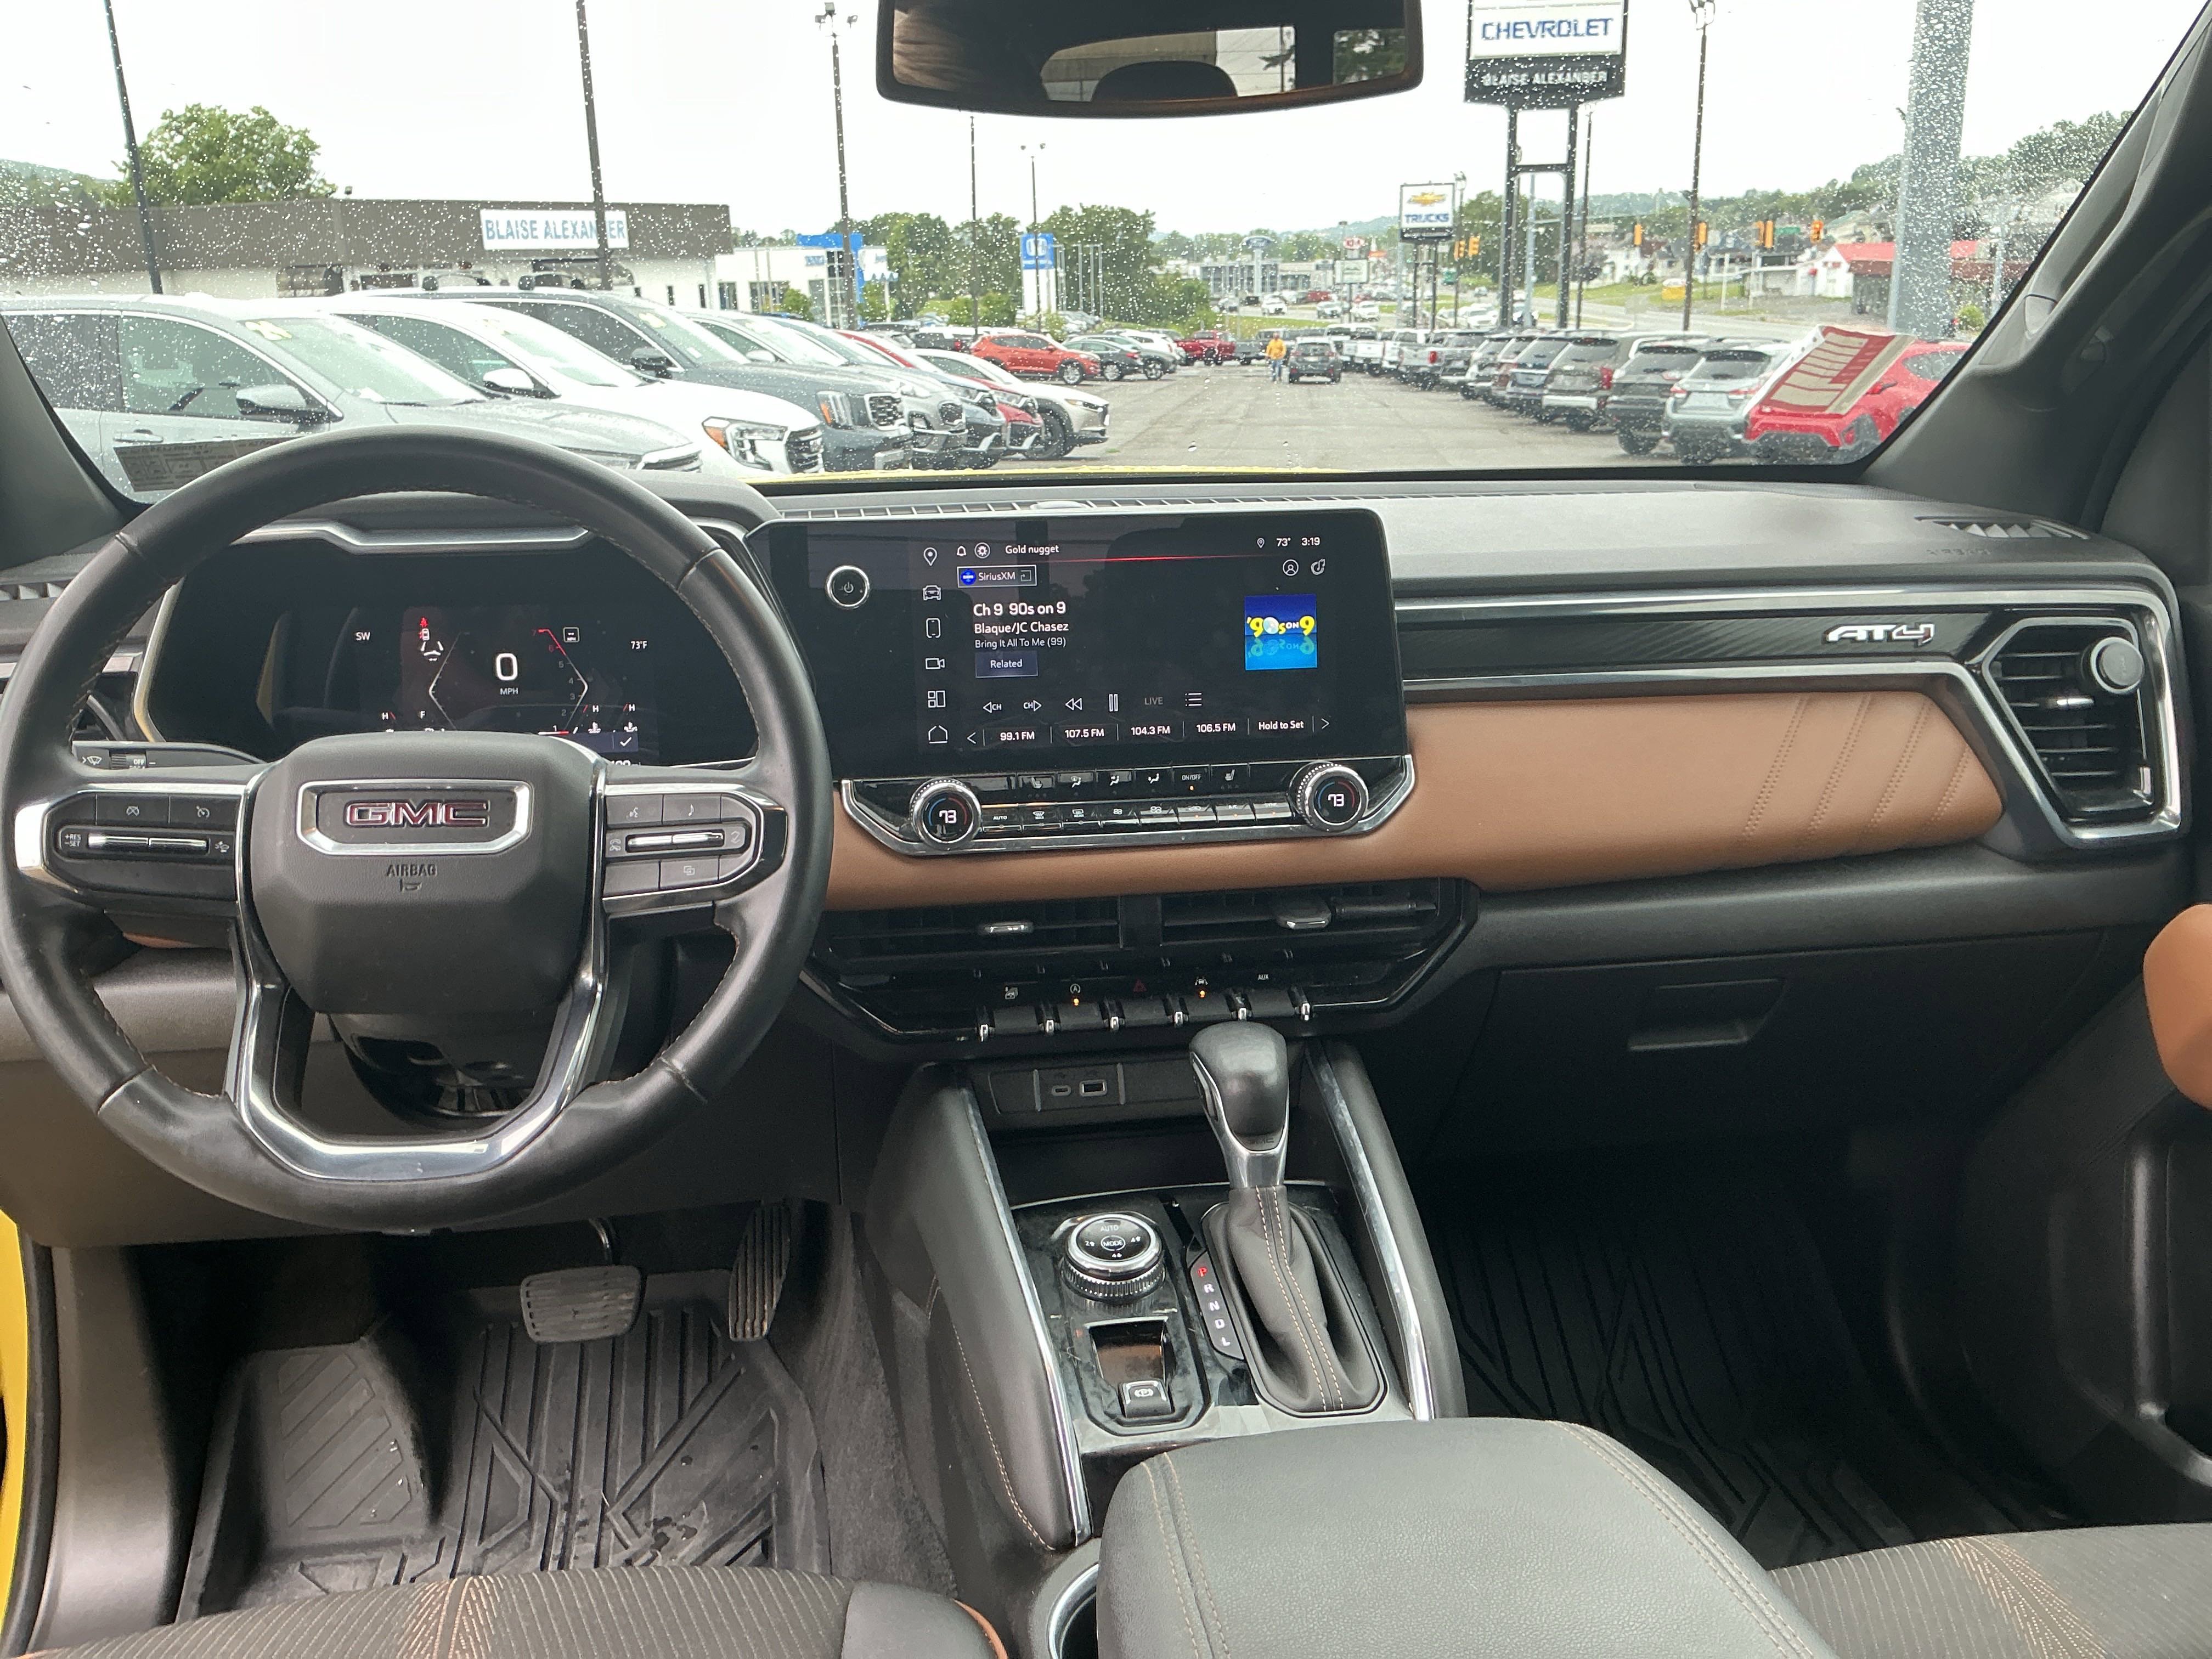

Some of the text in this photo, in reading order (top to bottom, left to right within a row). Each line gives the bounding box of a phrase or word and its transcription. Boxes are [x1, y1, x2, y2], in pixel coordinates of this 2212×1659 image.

[1482, 18, 1613, 40] CHEVROLET
[1405, 213, 1449, 223] TRUCKS
[485, 219, 627, 240] BLAISE ALEXANER
[1301, 537, 1321, 546] 3:19
[1005, 544, 1059, 556] Gold nugget
[978, 572, 1015, 581] SiriusXM
[973, 602, 1066, 617] Ch 9 90s on 9
[974, 622, 1069, 635] Blaque/JC Chasez
[1299, 616, 1315, 636] 9
[356, 631, 371, 641] SW
[1826, 623, 1934, 646] AT4
[975, 637, 1066, 650] Bring It All To Me (99)
[495, 653, 518, 680] 0
[990, 659, 1023, 668] Related
[1144, 696, 1164, 706] LIVE
[629, 703, 635, 712] H
[420, 711, 426, 720] F
[1196, 723, 1236, 733] 106.5 FM
[1258, 720, 1304, 730] Hold to Set
[1000, 731, 1035, 741] 99.1 FM
[1064, 729, 1104, 738] 107.5 FM
[1131, 726, 1171, 736] 104.3 FM
[1328, 793, 1344, 807] 73
[347, 801, 488, 826] GMC
[939, 810, 957, 823] 73
[386, 863, 438, 877] AIRBAG
[1198, 1267, 1207, 1277] P
[1204, 1283, 1215, 1294] R
[1209, 1300, 1221, 1311] N
[1215, 1318, 1226, 1329] D
[1221, 1336, 1231, 1347] L
